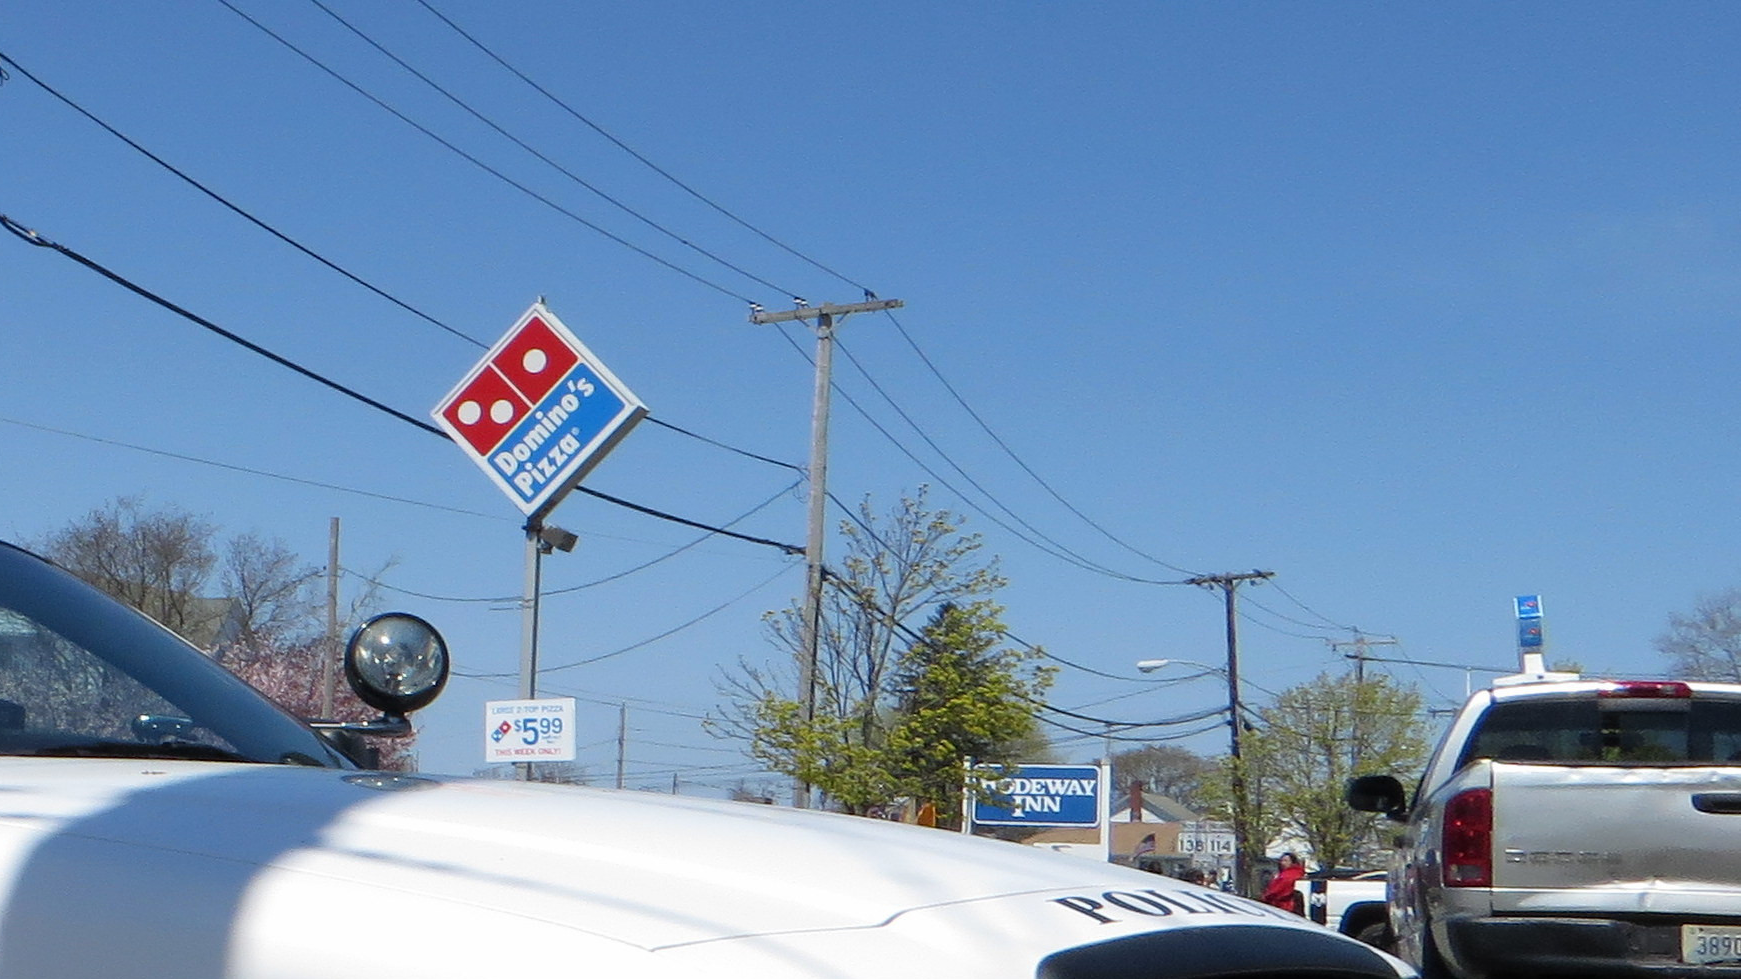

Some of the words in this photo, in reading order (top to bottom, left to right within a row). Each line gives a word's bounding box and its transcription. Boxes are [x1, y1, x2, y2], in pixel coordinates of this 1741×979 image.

[493, 377, 595, 477] Domino's
[513, 432, 581, 498] Pizza
[1012, 796, 1062, 818] INN
[1179, 839, 1204, 852] 138
[1210, 840, 1232, 853] 114
